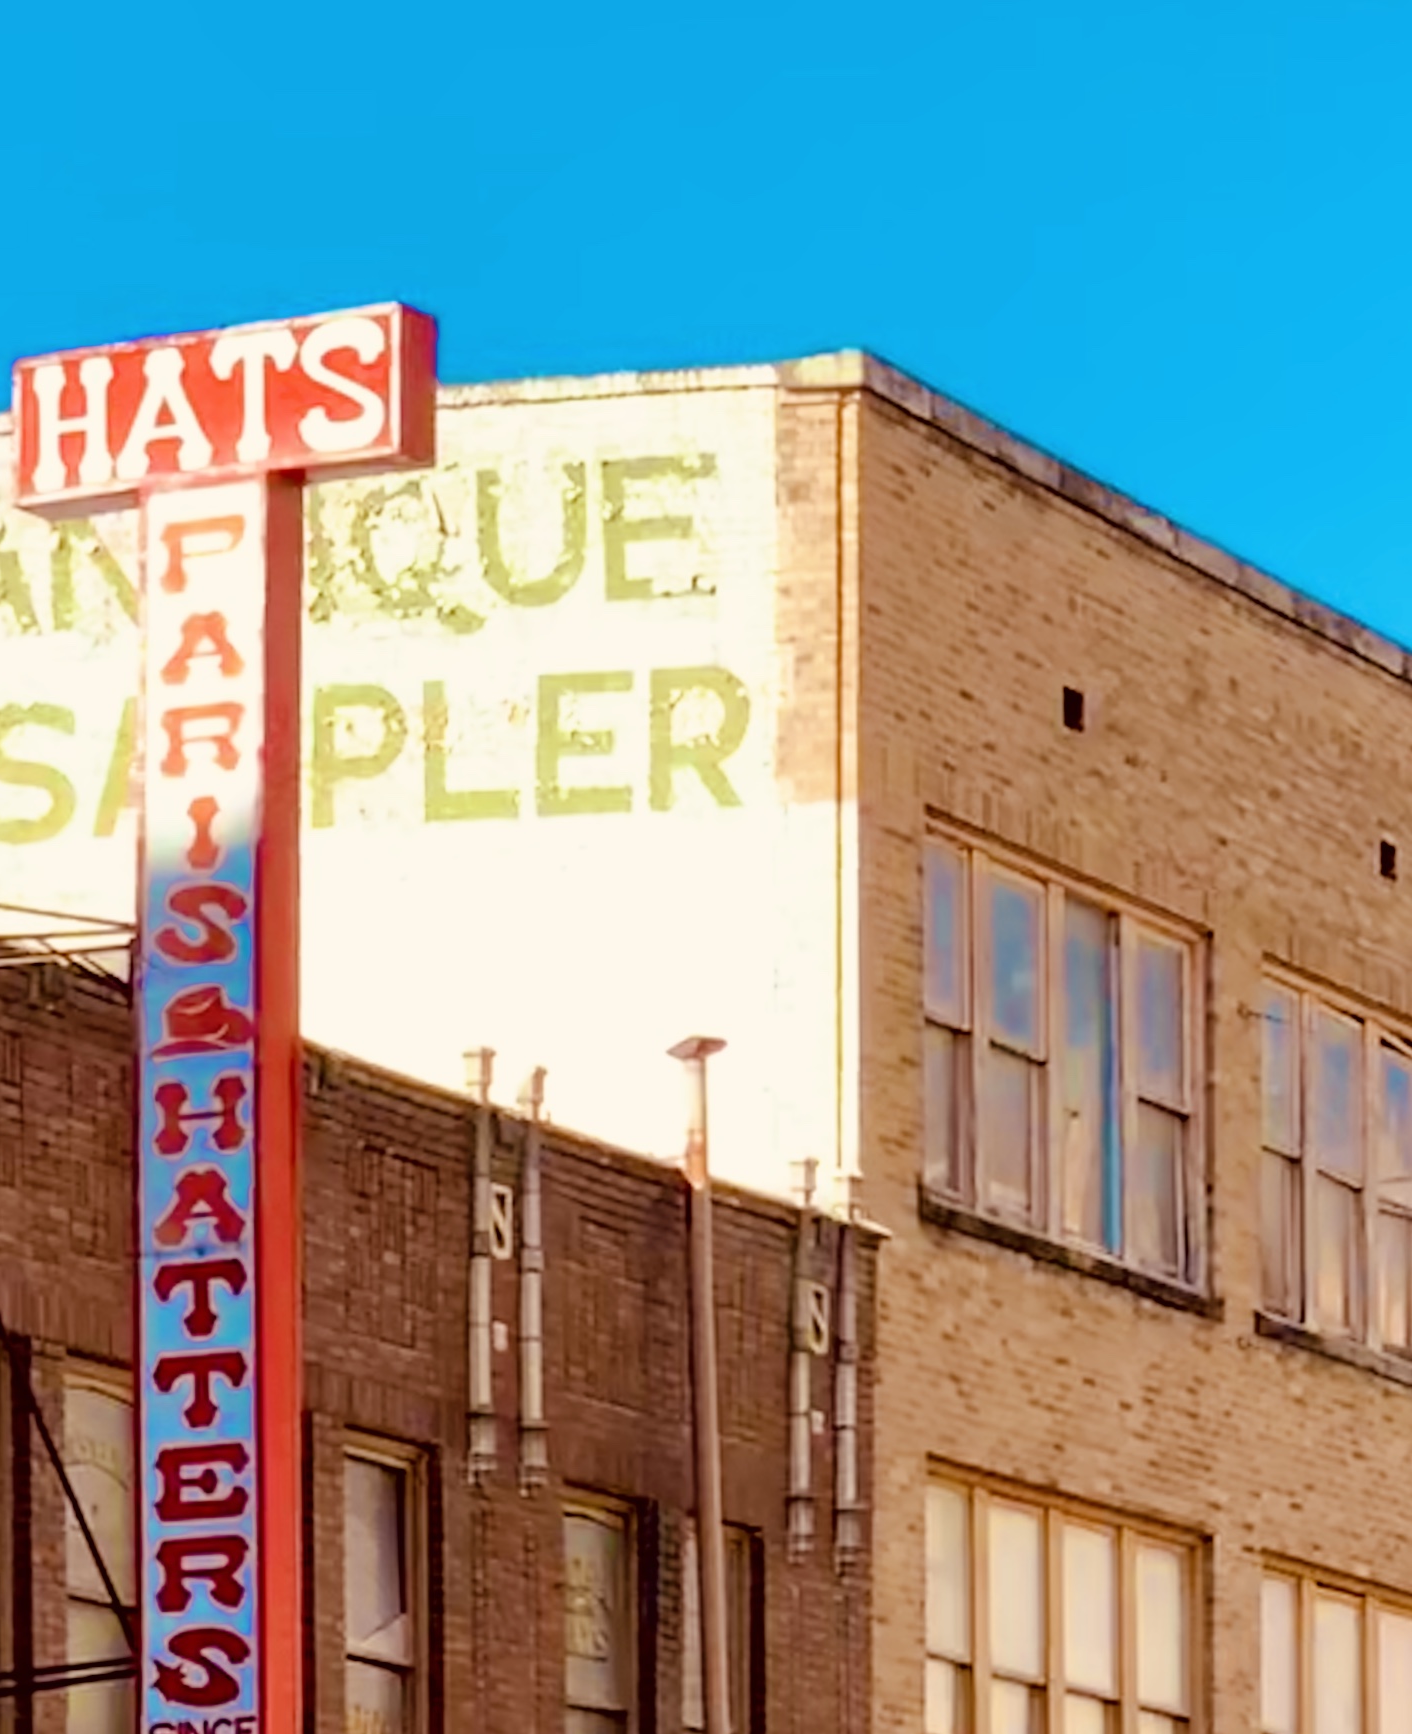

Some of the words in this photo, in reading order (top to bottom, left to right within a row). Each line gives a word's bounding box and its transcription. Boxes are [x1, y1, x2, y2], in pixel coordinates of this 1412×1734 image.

[31, 315, 386, 491] HATS
[155, 514, 248, 964] PARIS
[152, 1074, 250, 1708] HATTERS
